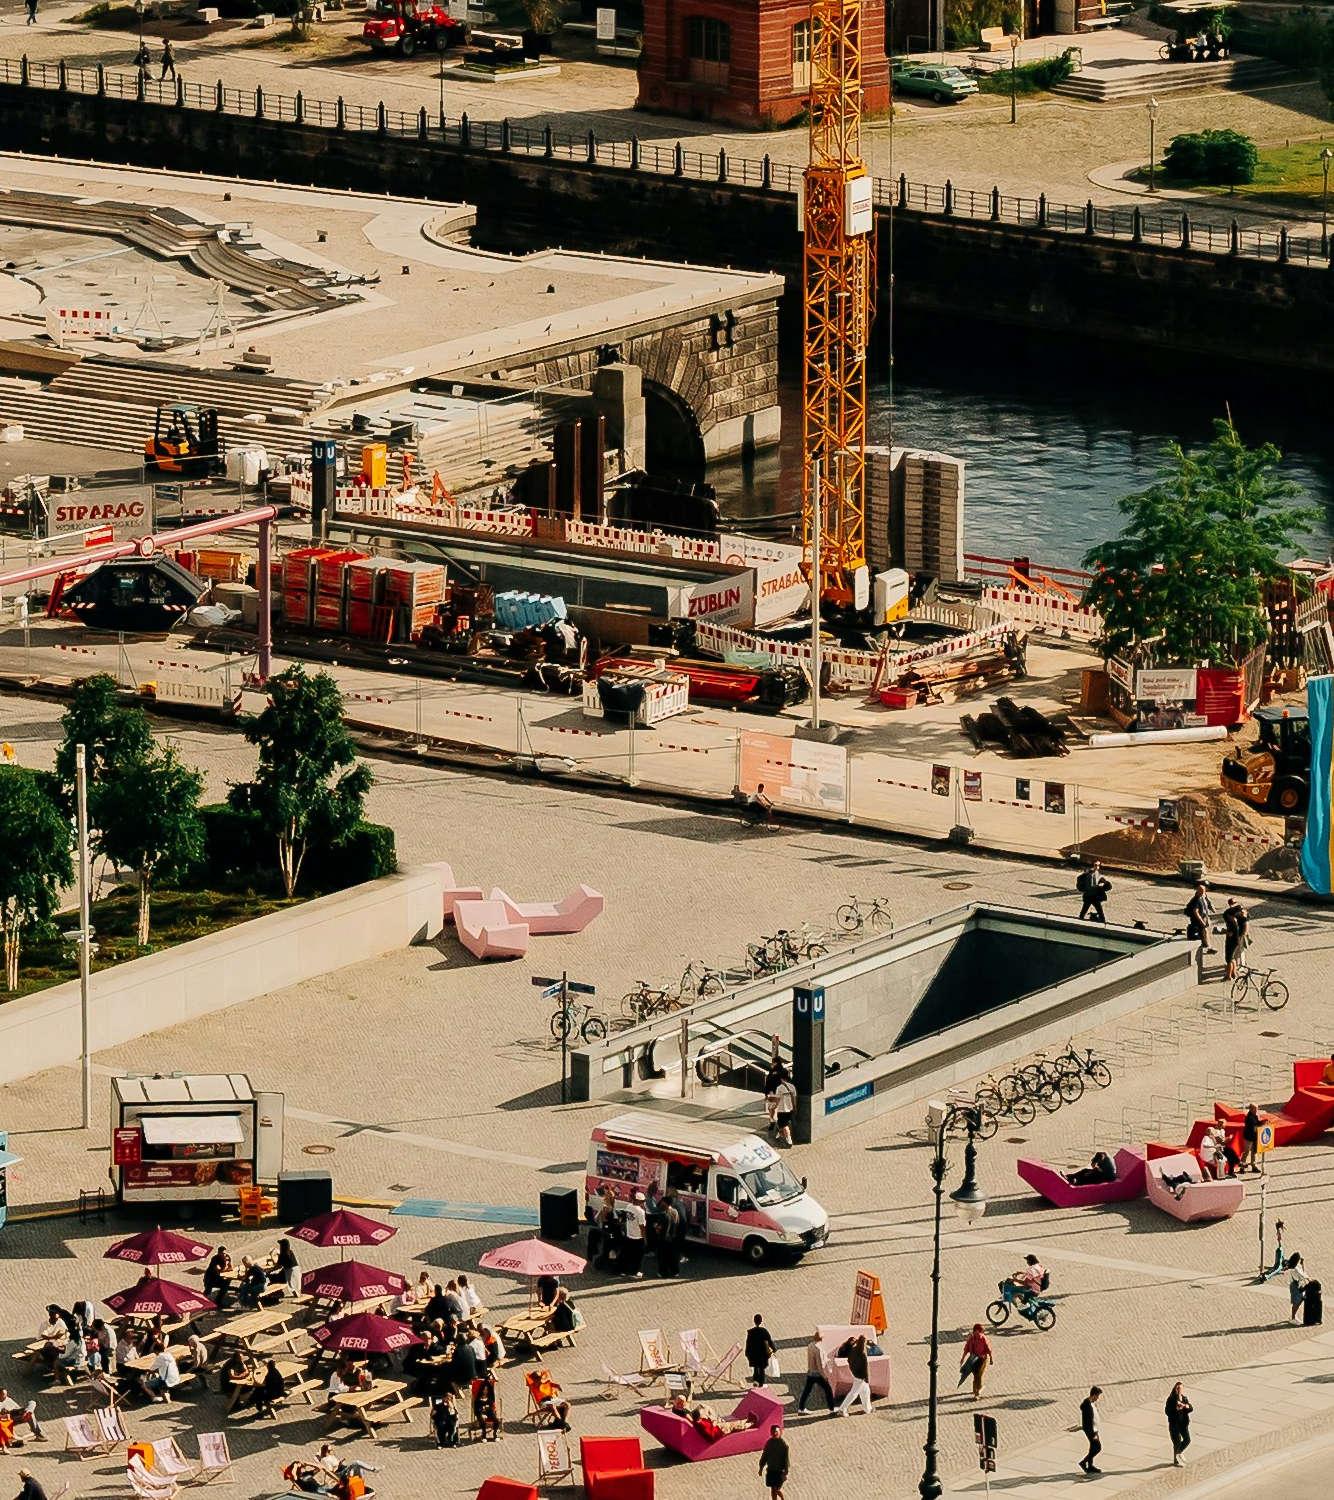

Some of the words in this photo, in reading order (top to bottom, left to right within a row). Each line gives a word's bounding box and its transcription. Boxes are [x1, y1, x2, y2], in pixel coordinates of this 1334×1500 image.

[315, 447, 323, 459] U
[327, 446, 335, 459] U
[56, 501, 145, 522] STRABAG
[688, 586, 741, 618] ZÜBLIN
[797, 996, 808, 1013] U
[813, 995, 823, 1013] U
[333, 1234, 361, 1245] KERB
[158, 1251, 187, 1262] KERB
[496, 1257, 522, 1269] KERB
[316, 1284, 344, 1297] KERB
[360, 1284, 388, 1298] KERB
[134, 1301, 163, 1313] KERB
[340, 1336, 369, 1349] KERB
